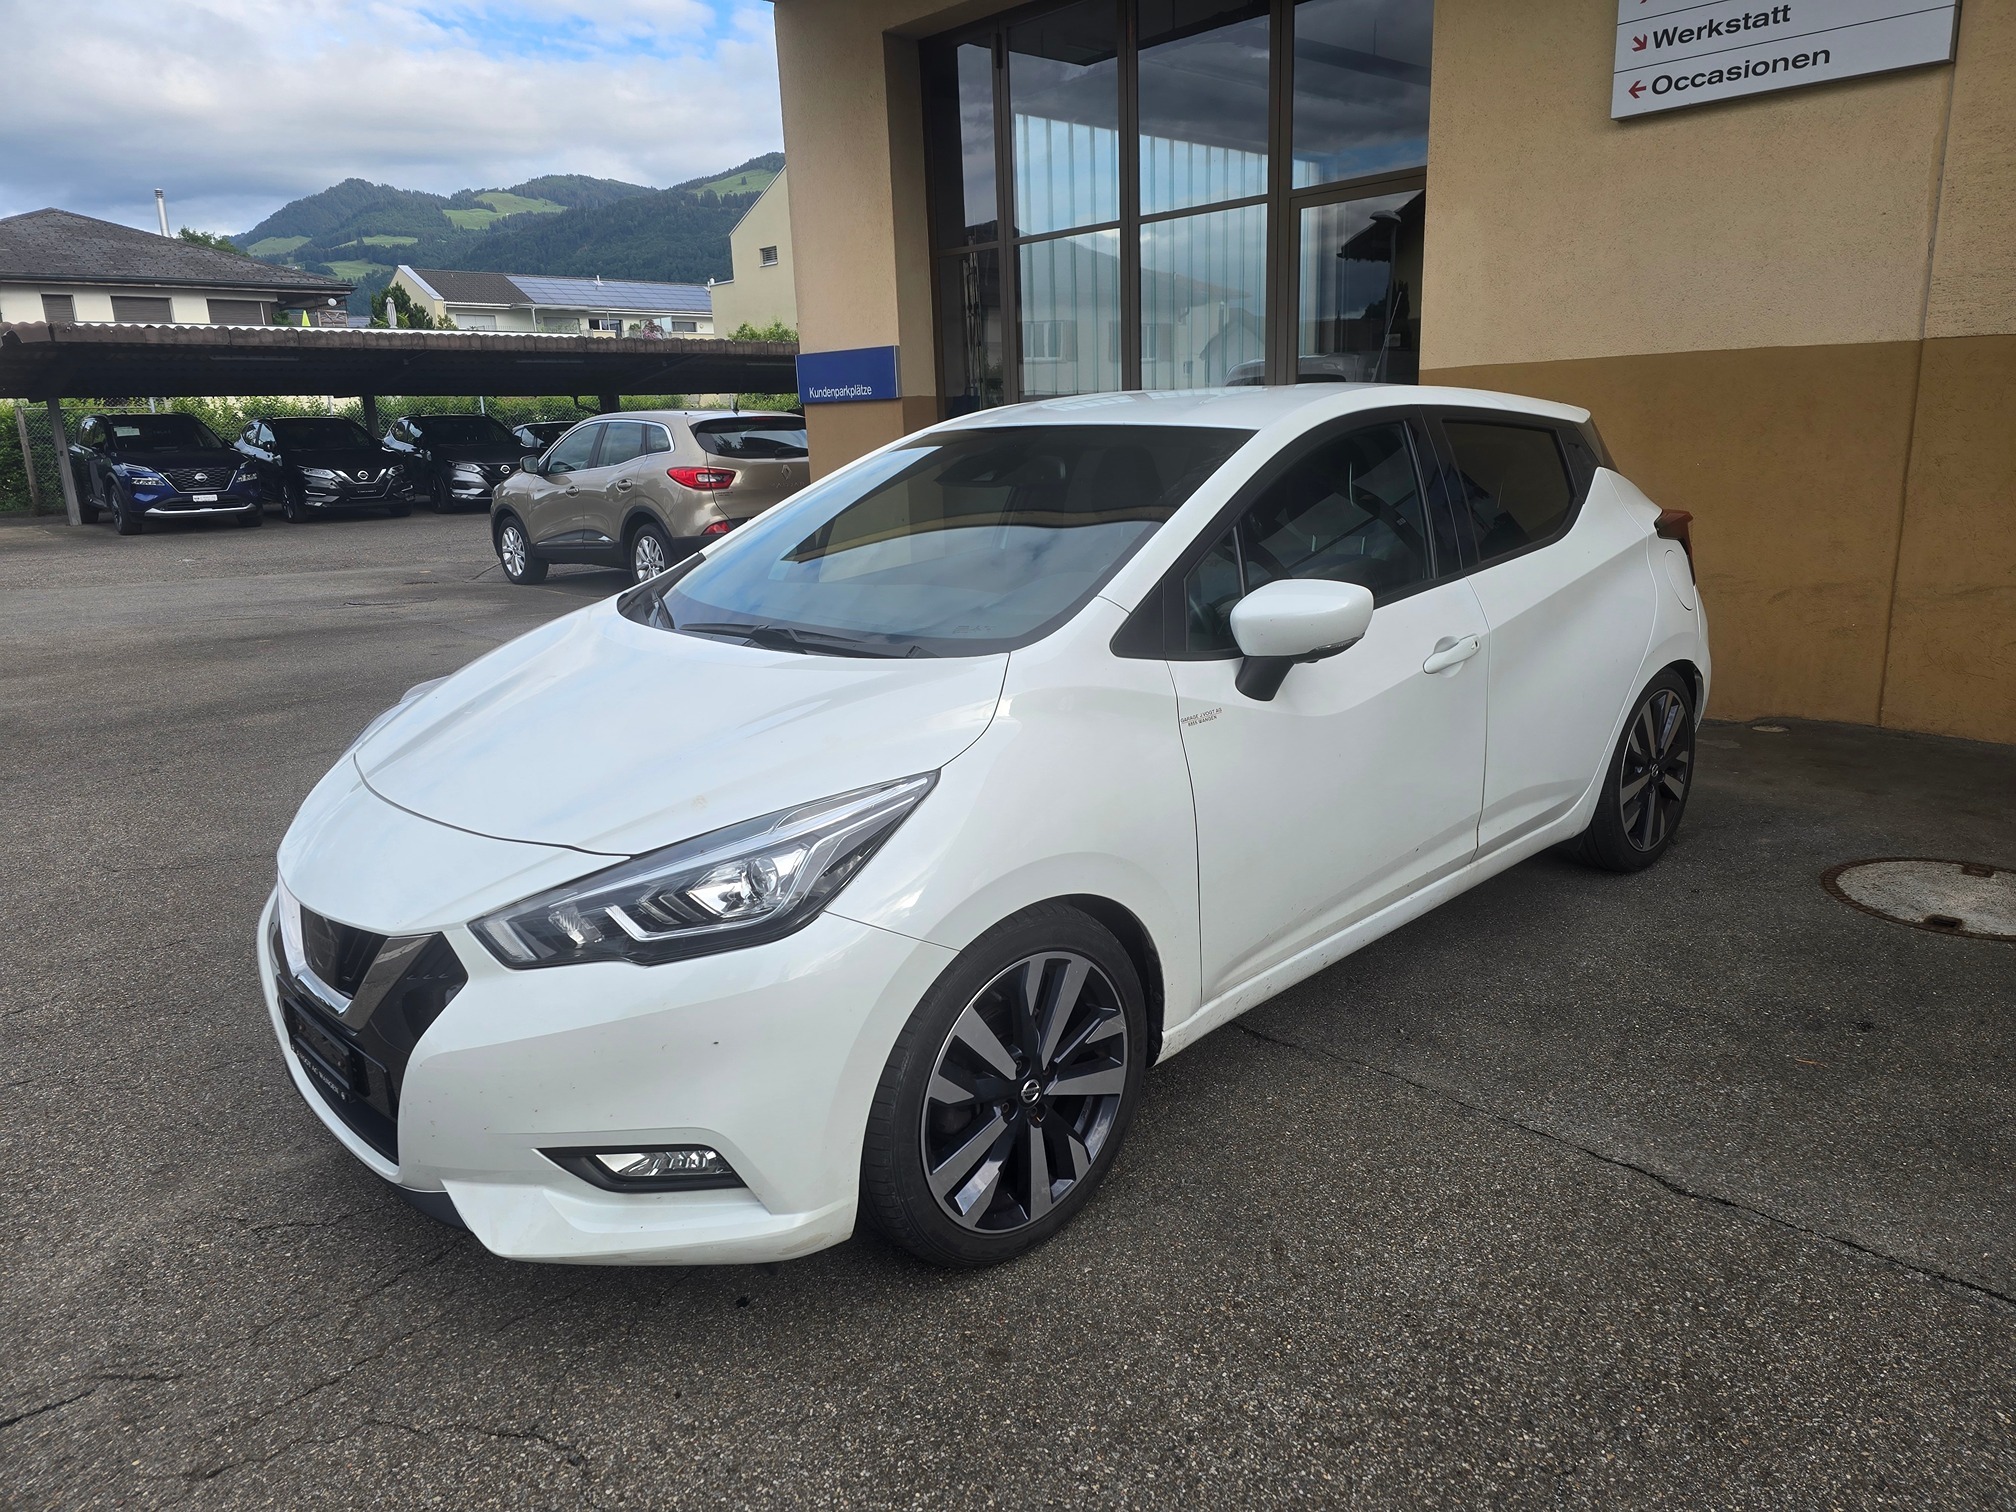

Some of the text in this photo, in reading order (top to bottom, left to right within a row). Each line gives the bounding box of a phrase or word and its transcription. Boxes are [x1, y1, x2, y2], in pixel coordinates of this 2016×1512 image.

[1652, 4, 1791, 49] Werkstatt
[1651, 49, 1831, 95] Occasionen
[808, 384, 872, 399] Kundenparkplätze
